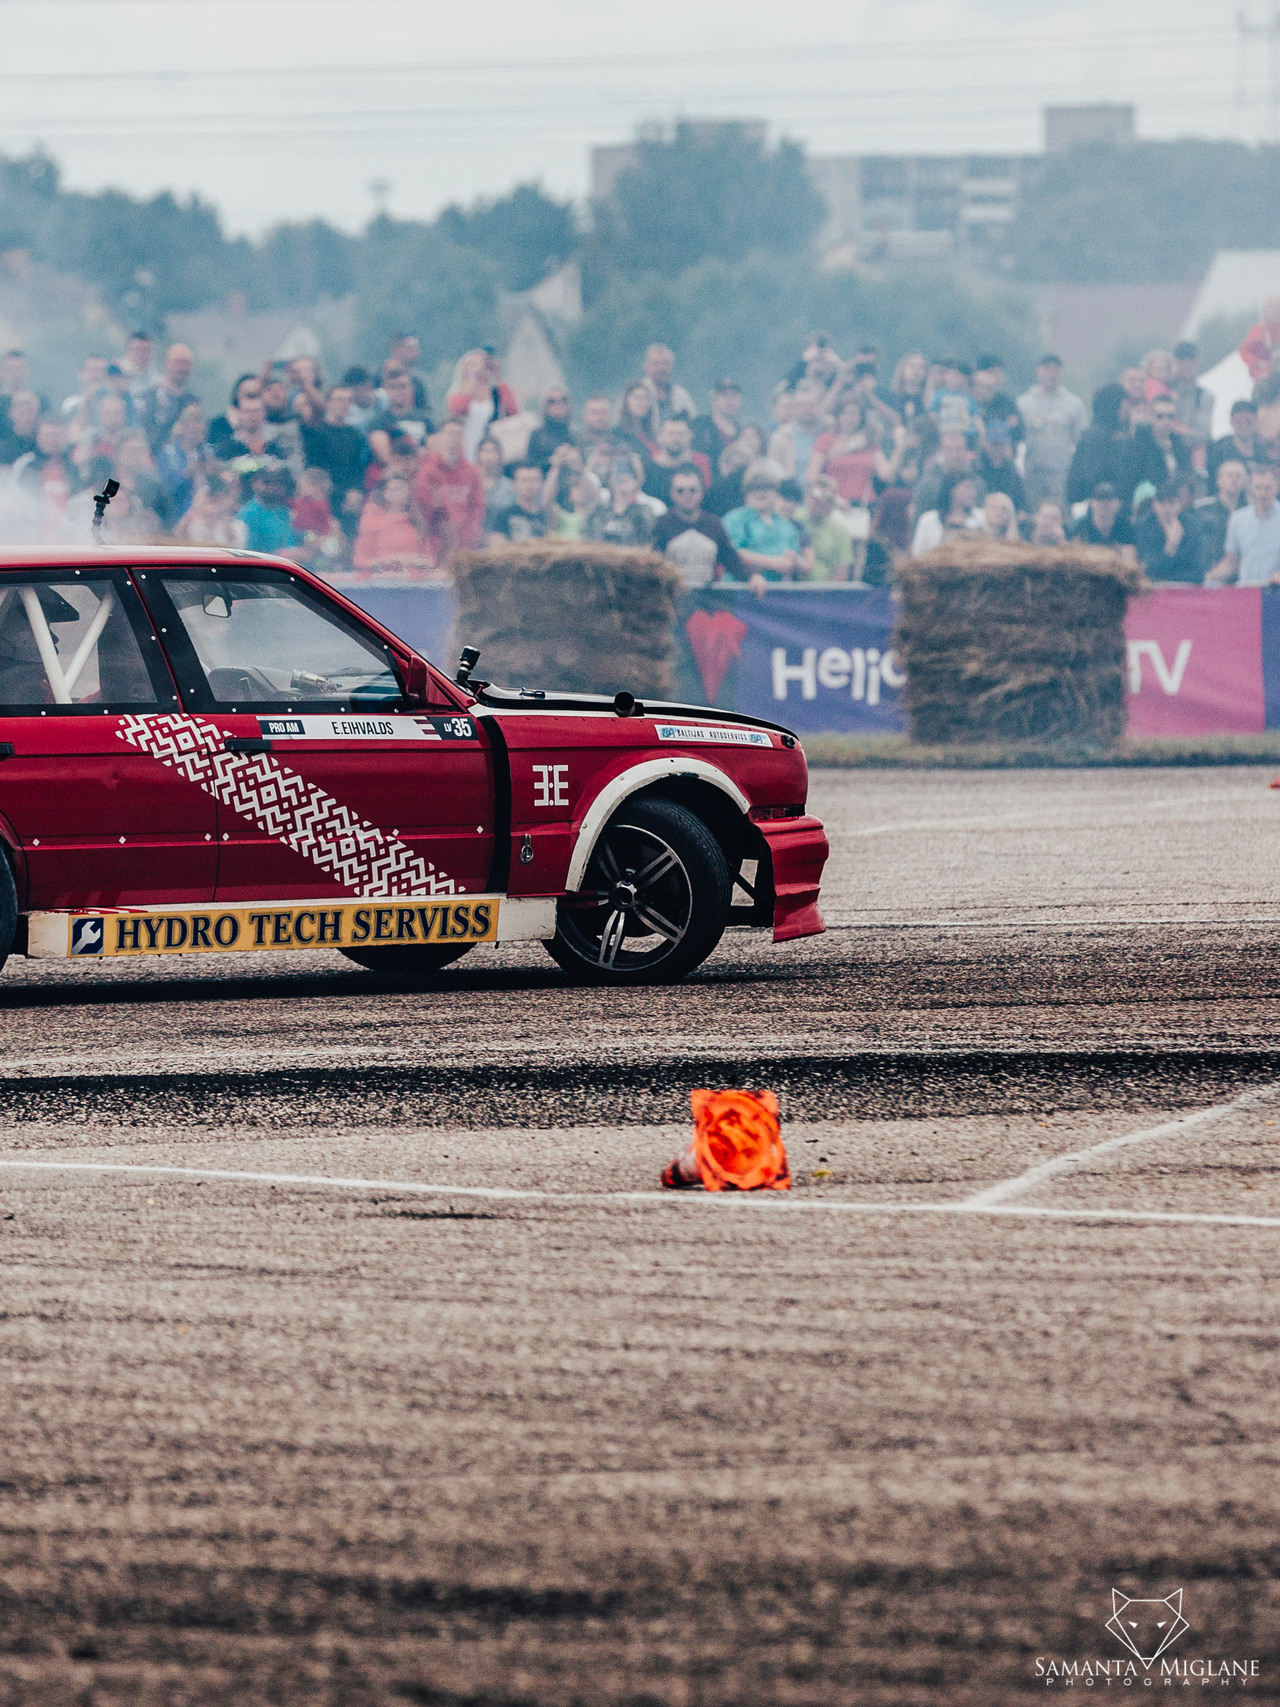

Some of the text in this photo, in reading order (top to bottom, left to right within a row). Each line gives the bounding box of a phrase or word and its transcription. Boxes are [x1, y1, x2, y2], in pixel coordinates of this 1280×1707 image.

[269, 722, 300, 733] PRO AM
[453, 718, 472, 737] 35
[117, 905, 491, 950] HYDRO TECH SERVISS
